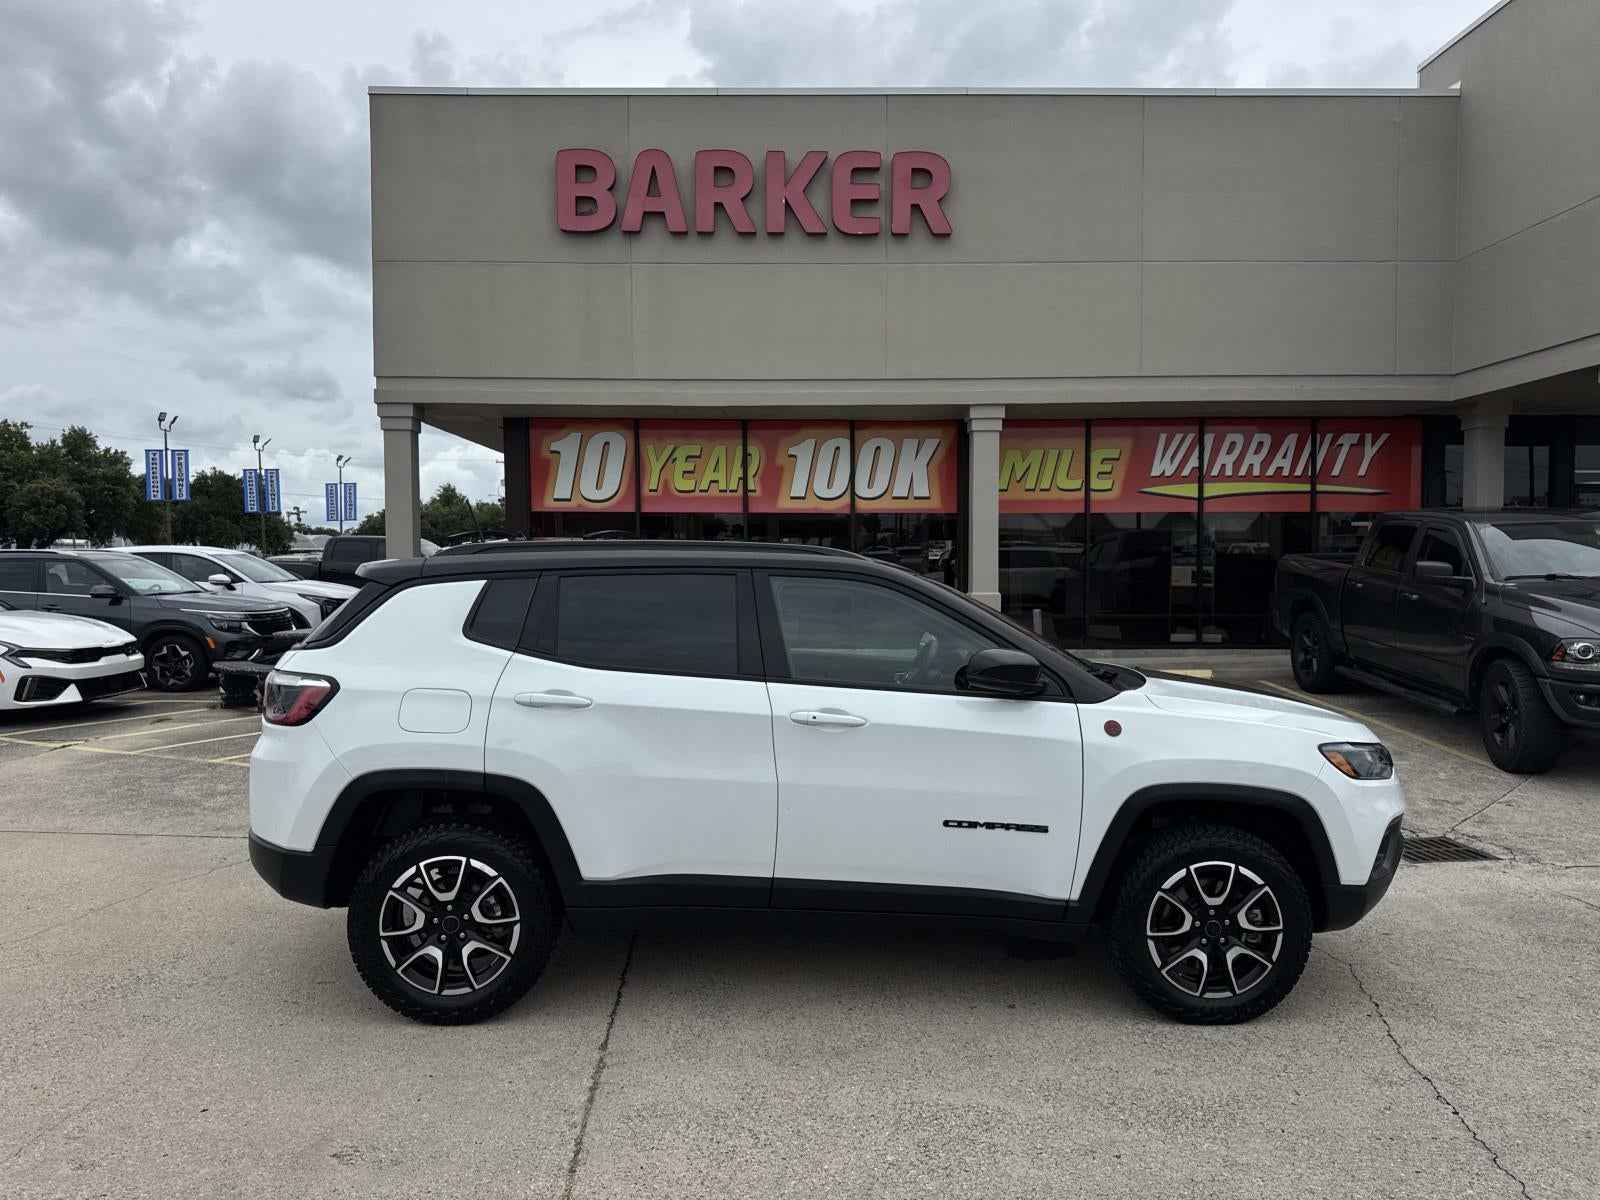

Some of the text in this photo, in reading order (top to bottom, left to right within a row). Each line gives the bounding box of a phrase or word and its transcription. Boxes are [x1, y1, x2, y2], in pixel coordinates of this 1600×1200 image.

[556, 148, 952, 236] BARKER
[549, 431, 1390, 502] 10 YEAR 100K MILE WARRANTY
[942, 819, 1049, 834] COMPASS
